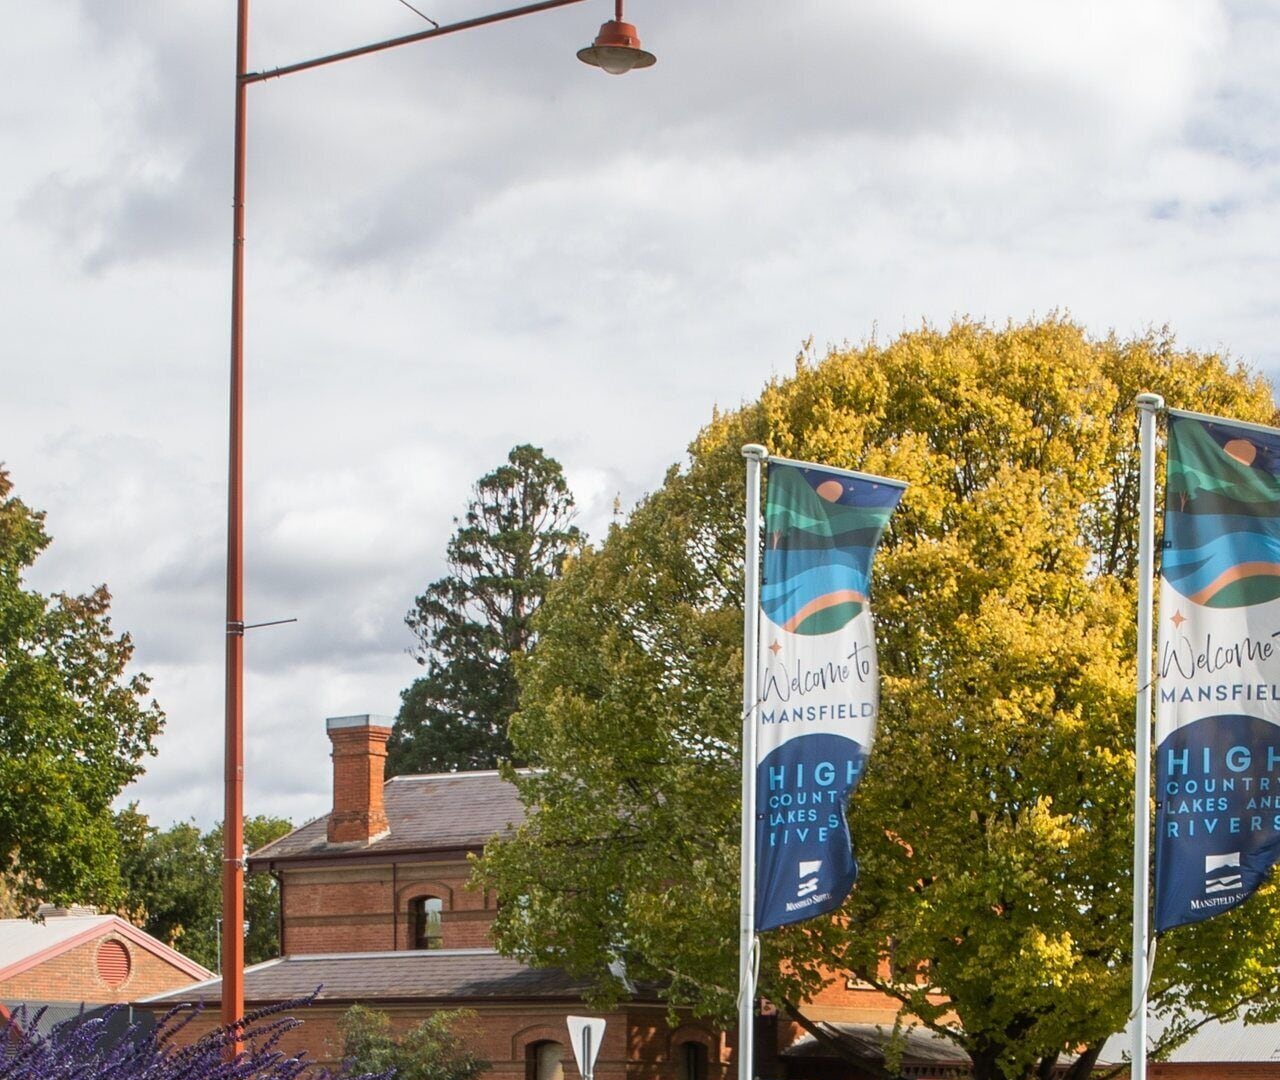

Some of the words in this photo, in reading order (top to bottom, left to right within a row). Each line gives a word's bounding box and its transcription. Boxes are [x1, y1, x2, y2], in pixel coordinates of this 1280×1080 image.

[1162, 633, 1274, 680] Welcome
[763, 659, 849, 703] Welcome
[847, 641, 871, 683] to
[761, 702, 874, 725] MANSFIELD
[769, 760, 863, 791] HIGH
[1167, 797, 1228, 814] LAKES
[770, 808, 818, 827] LAKES
[1190, 895, 1235, 911] MANSFIELD
